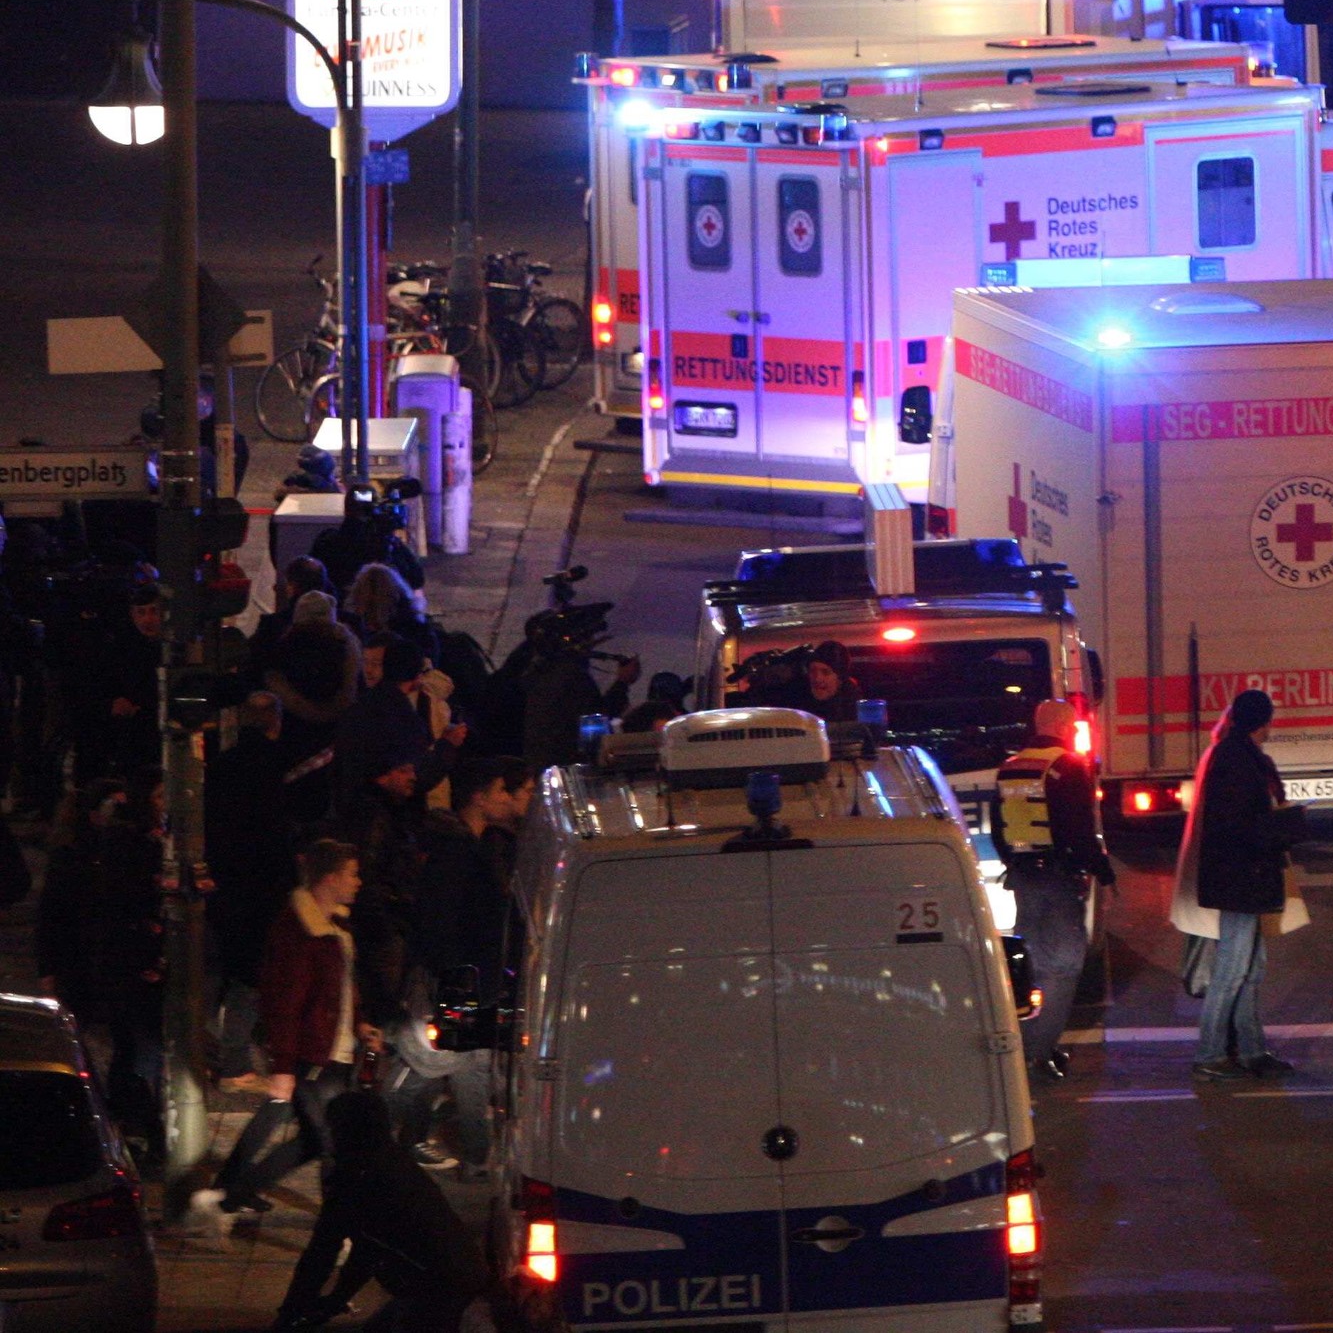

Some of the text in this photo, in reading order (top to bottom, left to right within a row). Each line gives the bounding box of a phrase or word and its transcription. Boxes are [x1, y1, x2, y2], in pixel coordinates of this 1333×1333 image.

[347, 79, 438, 98] UINNESS
[1047, 193, 1139, 216] Deutsches
[1048, 219, 1098, 238] Rotes
[1048, 242, 1098, 259] Kreuz
[674, 355, 842, 388] RETTUNGSDIENST
[1162, 403, 1213, 439] SEG
[1255, 535, 1301, 582] ROTES
[1201, 675, 1238, 709] KV
[896, 901, 941, 930] 25
[582, 1273, 762, 1317] POLIZEI
